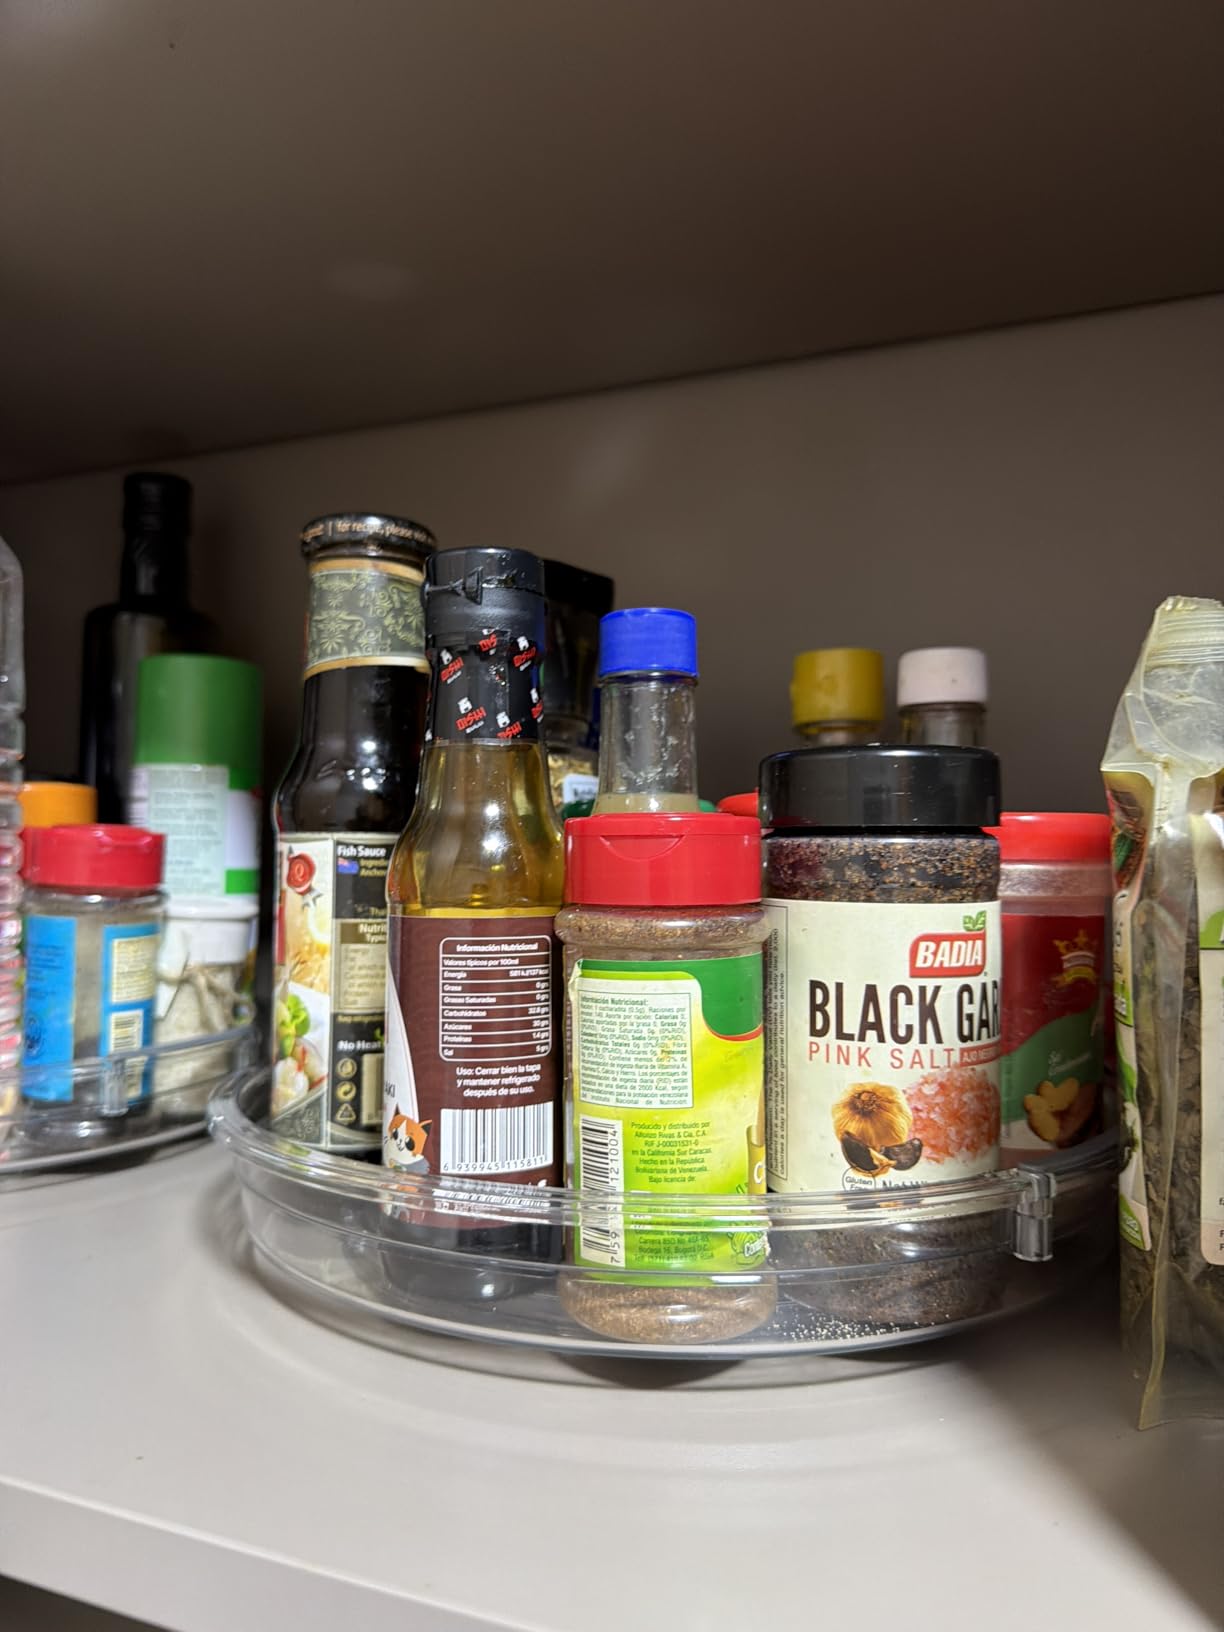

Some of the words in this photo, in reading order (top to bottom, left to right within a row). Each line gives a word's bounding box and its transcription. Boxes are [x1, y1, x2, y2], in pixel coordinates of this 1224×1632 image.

[337, 846, 357, 856] Fish
[358, 846, 386, 857] Sauce
[501, 943, 538, 951] Nutricional
[916, 940, 983, 968] BADIA
[444, 971, 467, 979] Energía
[809, 979, 944, 1045] BLACK
[337, 1040, 354, 1050] No
[809, 1041, 872, 1068] PINK
[890, 1048, 954, 1069] SALT
[456, 1067, 474, 1075] Uso:
[475, 1067, 500, 1075] Cerrar
[501, 1065, 517, 1074] bien
[518, 1064, 525, 1072] la
[526, 1064, 541, 1072] tapa
[456, 1079, 463, 1087] y
[501, 1073, 540, 1085] refrigerado
[463, 1088, 497, 1098] después
[846, 1176, 872, 1185] Gluten
